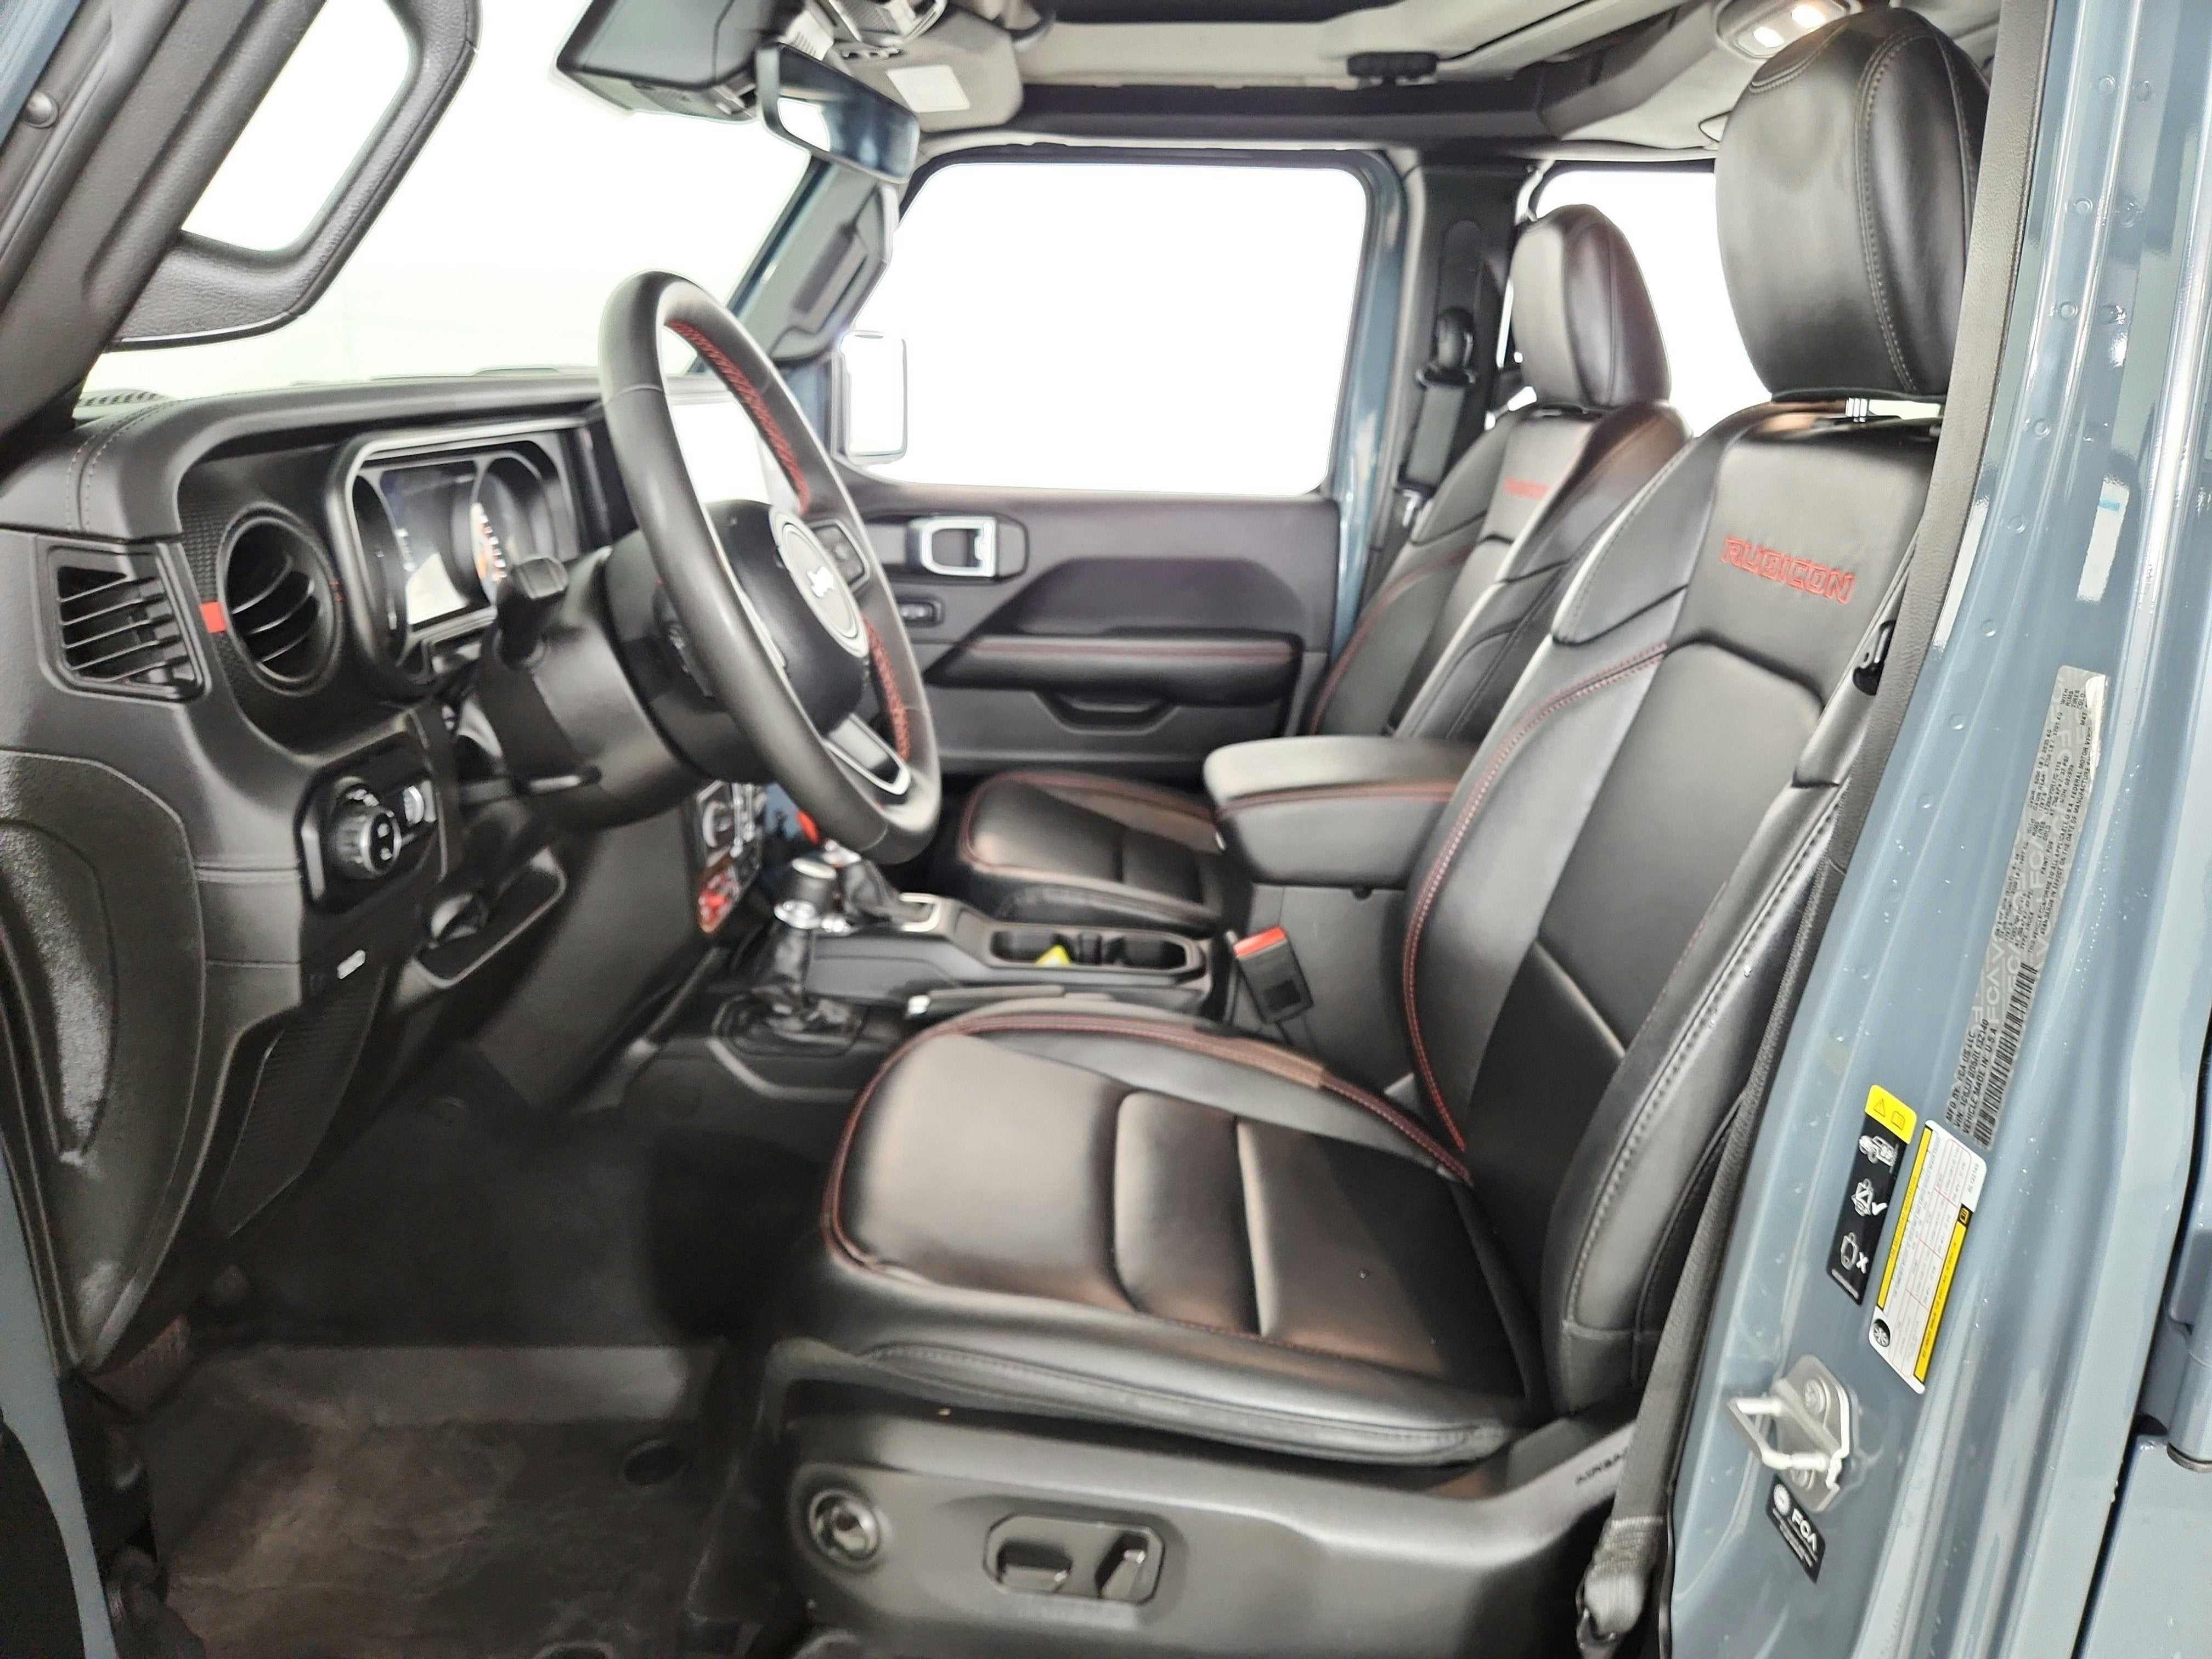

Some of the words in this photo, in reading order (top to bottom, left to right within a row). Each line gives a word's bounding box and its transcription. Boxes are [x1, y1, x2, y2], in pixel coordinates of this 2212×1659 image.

[1720, 537, 1855, 603] RUBICON
[2065, 690, 2073, 706] RIMS
[2071, 689, 2079, 707] TIRES
[2076, 693, 2085, 709] COLD
[2037, 821, 2045, 838] TIRES
[2042, 825, 2051, 841] COLD
[2032, 915, 2042, 939] VEHICLE
[2039, 881, 2051, 913] CONFORMS
[2054, 821, 2068, 857] APPLICABLE
[2070, 770, 2081, 799] FEDERAL
[2078, 747, 2088, 769] MOTOR
[2040, 899, 2053, 935] STANDARDS
[2052, 867, 2062, 889] EFFECT
[2065, 825, 2074, 841] DATE
[2073, 766, 2090, 814] MANUFACTURE
[2024, 911, 2033, 930] TRUCK
[1965, 1030, 1975, 1048] LLC
[1961, 1048, 1970, 1062] US
[1956, 1063, 1966, 1081] FCA
[1945, 1100, 1956, 1121] MFD
[1962, 1098, 1977, 1134] VEHICLE
[1973, 1069, 1985, 1096] MADE
